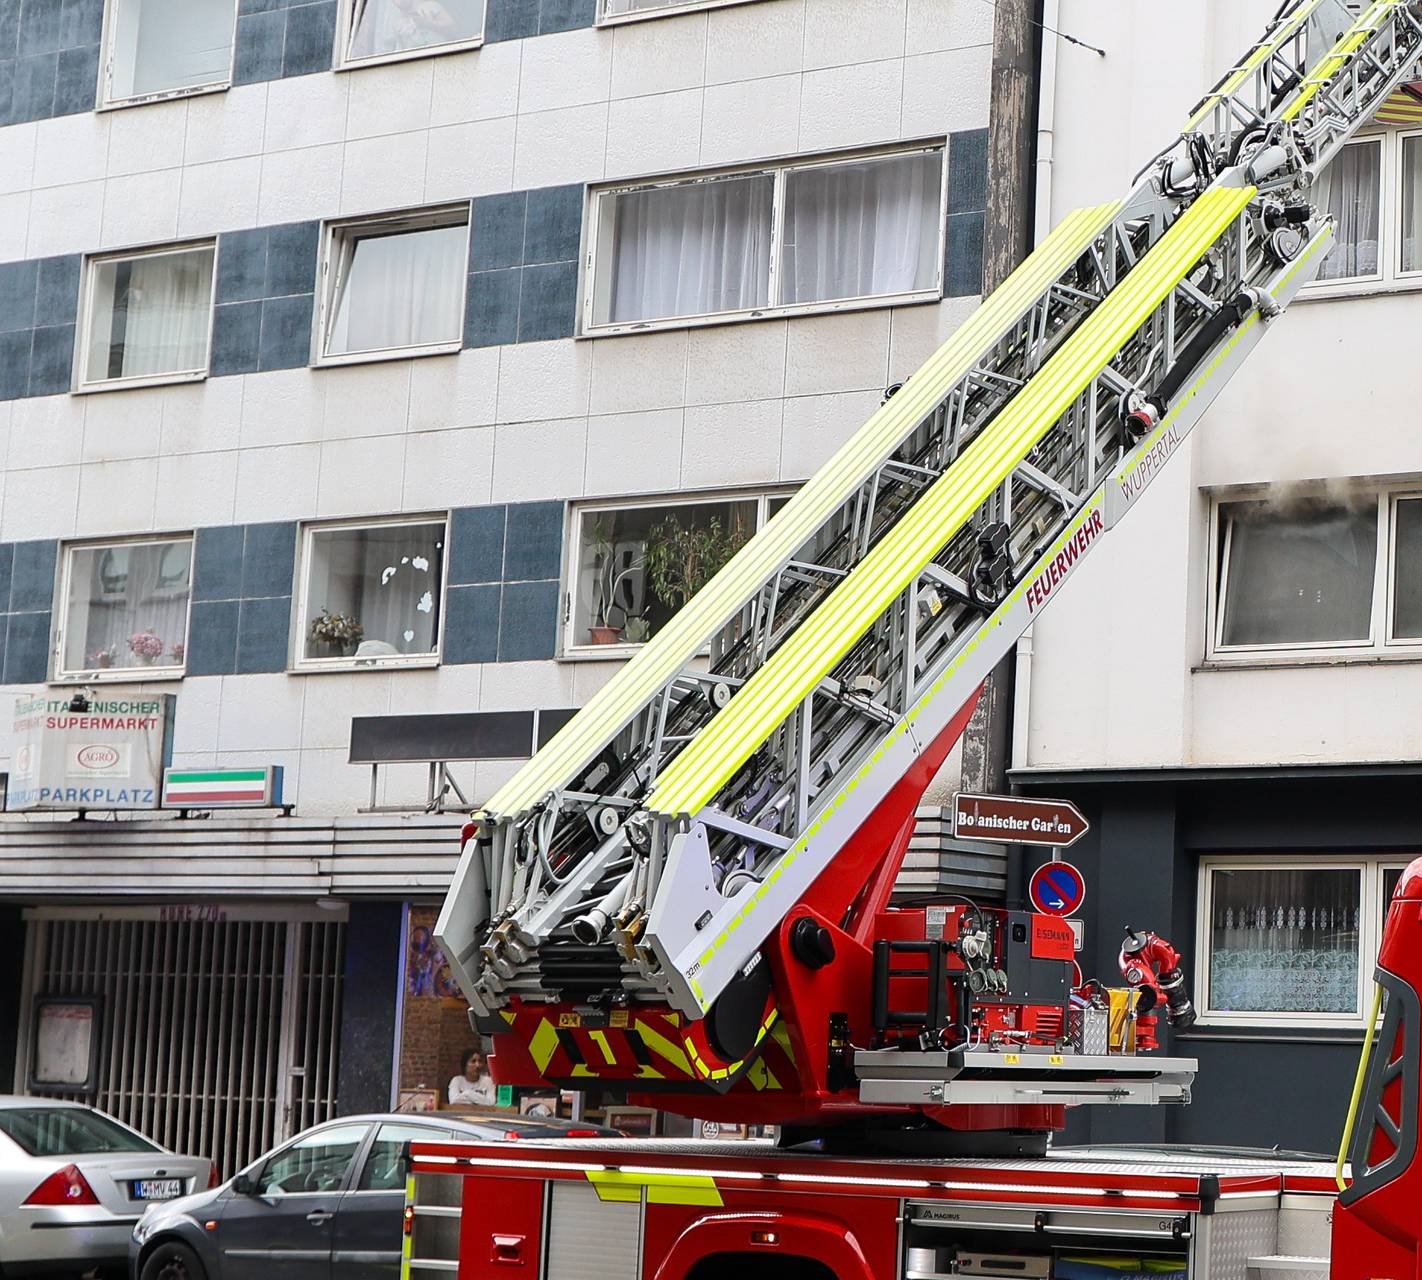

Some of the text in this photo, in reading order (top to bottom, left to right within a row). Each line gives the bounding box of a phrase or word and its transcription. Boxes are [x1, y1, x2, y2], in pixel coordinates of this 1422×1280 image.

[1120, 425, 1181, 502] WUPPERTAL
[1026, 509, 1104, 613] FEUERWEHR
[47, 701, 160, 715] ITAENISCHER
[46, 717, 157, 730] SUPERMARKT
[40, 788, 153, 803] PARKPLATZ
[685, 962, 701, 979] 32m
[588, 1030, 617, 1065] 1
[934, 1212, 960, 1220] MAGIRUS
[1158, 1221, 1171, 1231] G4
